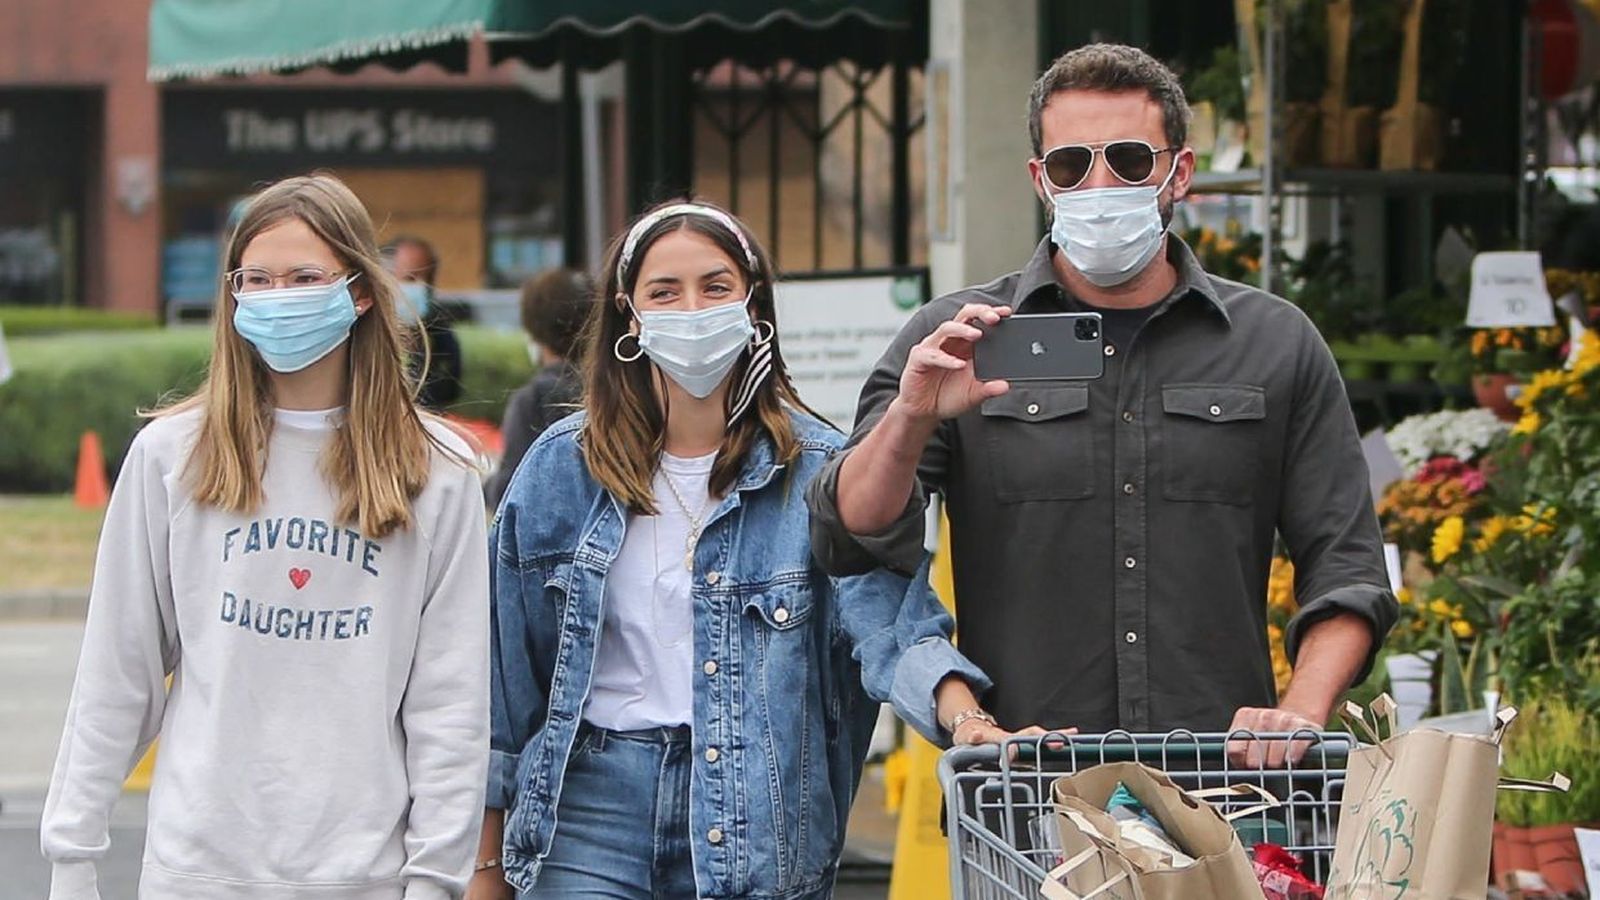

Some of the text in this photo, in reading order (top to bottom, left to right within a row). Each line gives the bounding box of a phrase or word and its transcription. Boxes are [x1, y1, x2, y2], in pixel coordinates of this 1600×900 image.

[225, 108, 494, 150] The UPS Store
[223, 517, 382, 577] FAVORITE
[221, 591, 373, 640] DAUGHTER
